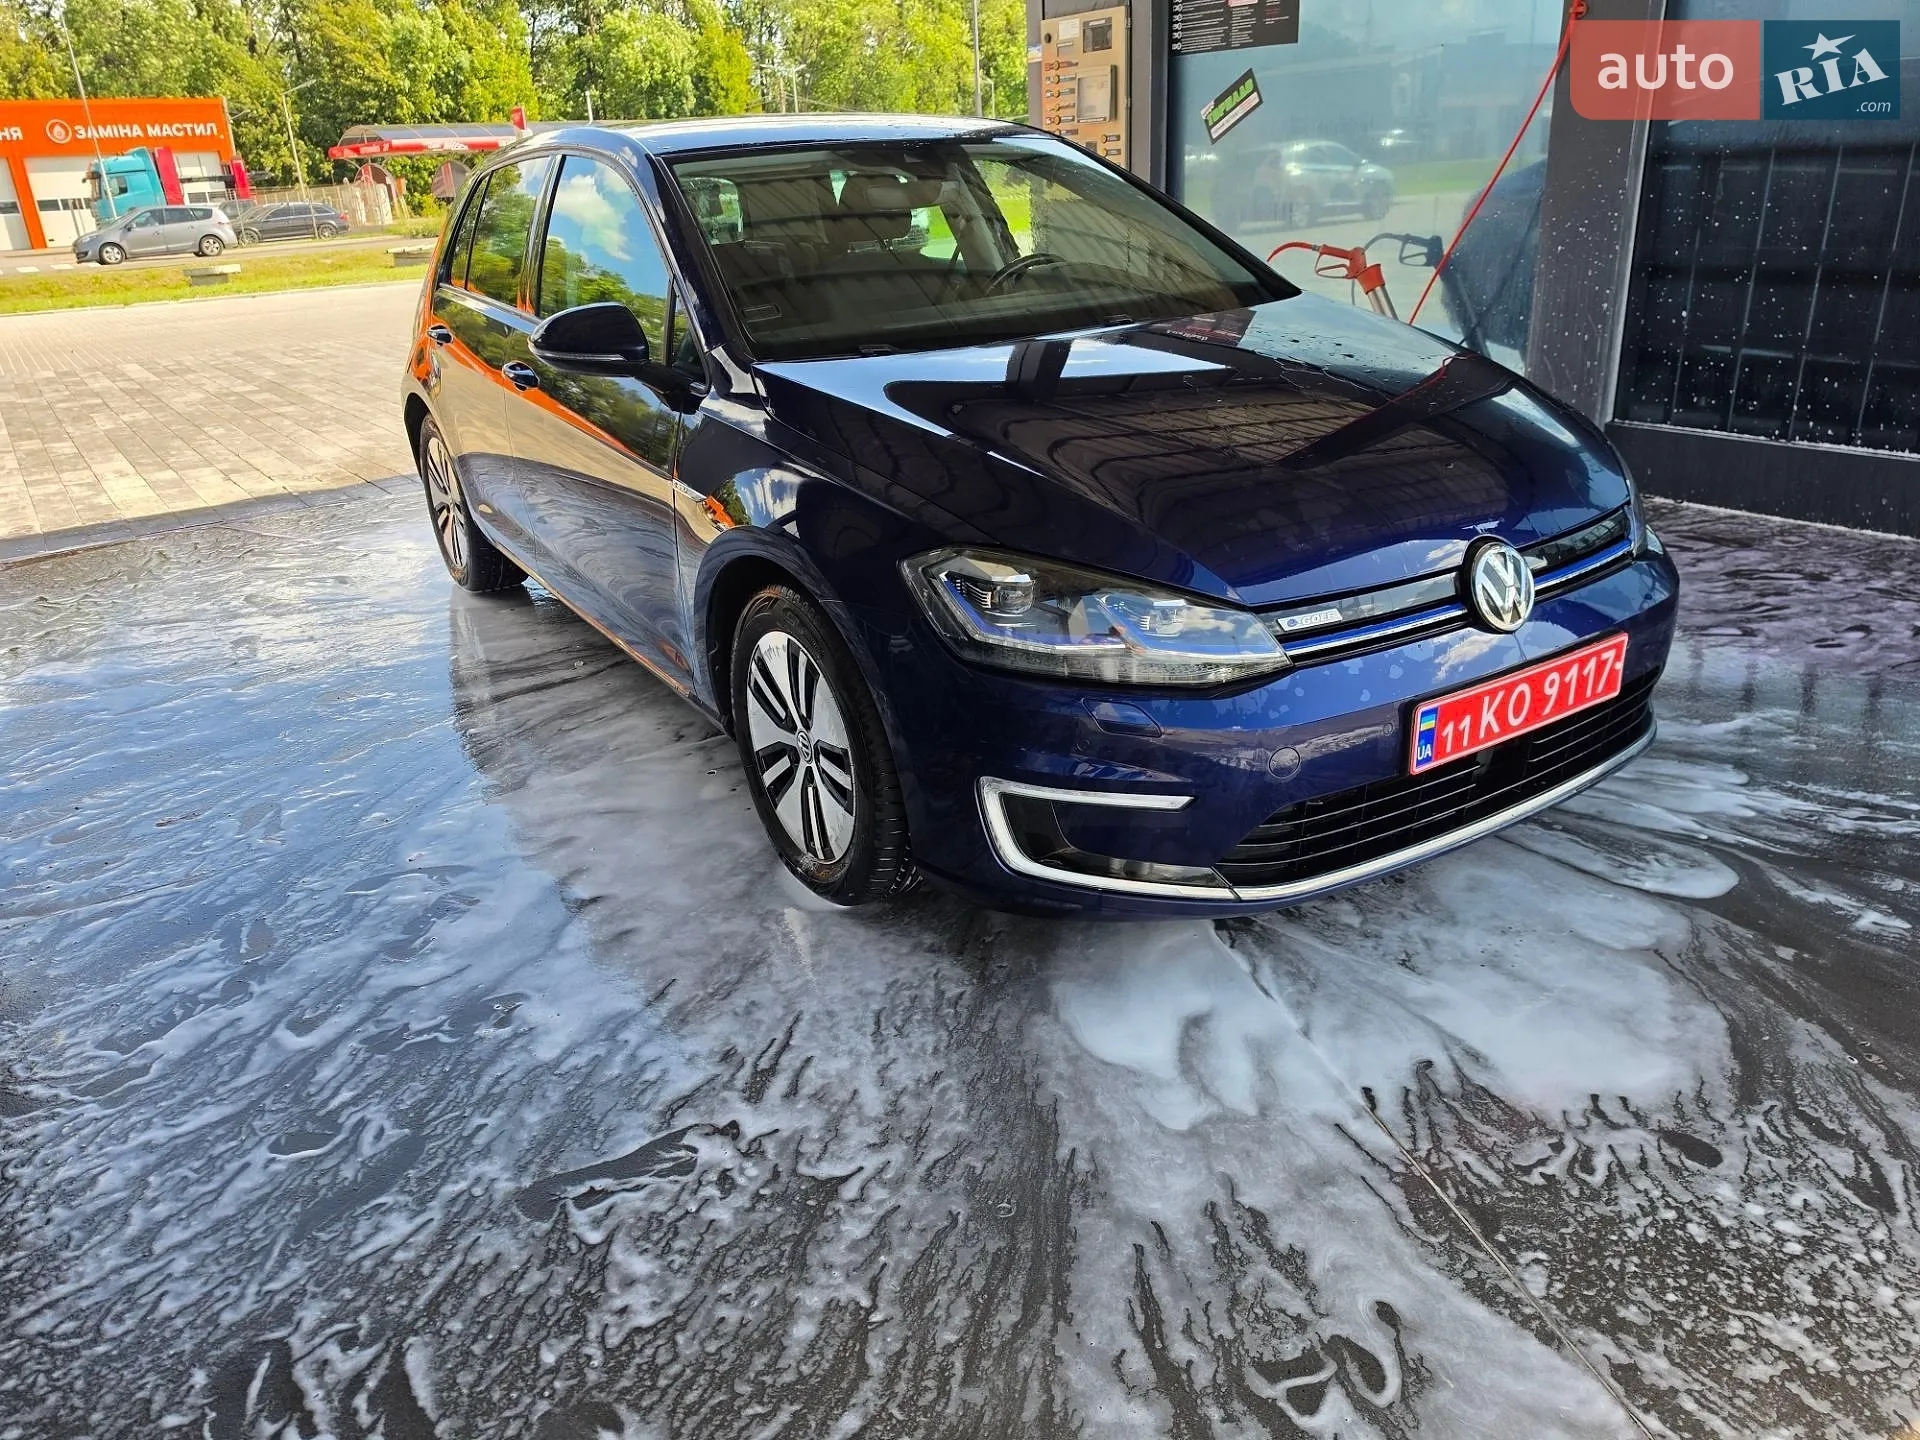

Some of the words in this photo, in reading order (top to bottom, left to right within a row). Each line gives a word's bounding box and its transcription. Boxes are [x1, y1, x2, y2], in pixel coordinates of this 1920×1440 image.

[74, 124, 144, 140] ЗАМІНА
[147, 122, 218, 137] МАСТИЛ
[1542, 649, 1617, 716] 9117
[1417, 743, 1432, 760] UA
